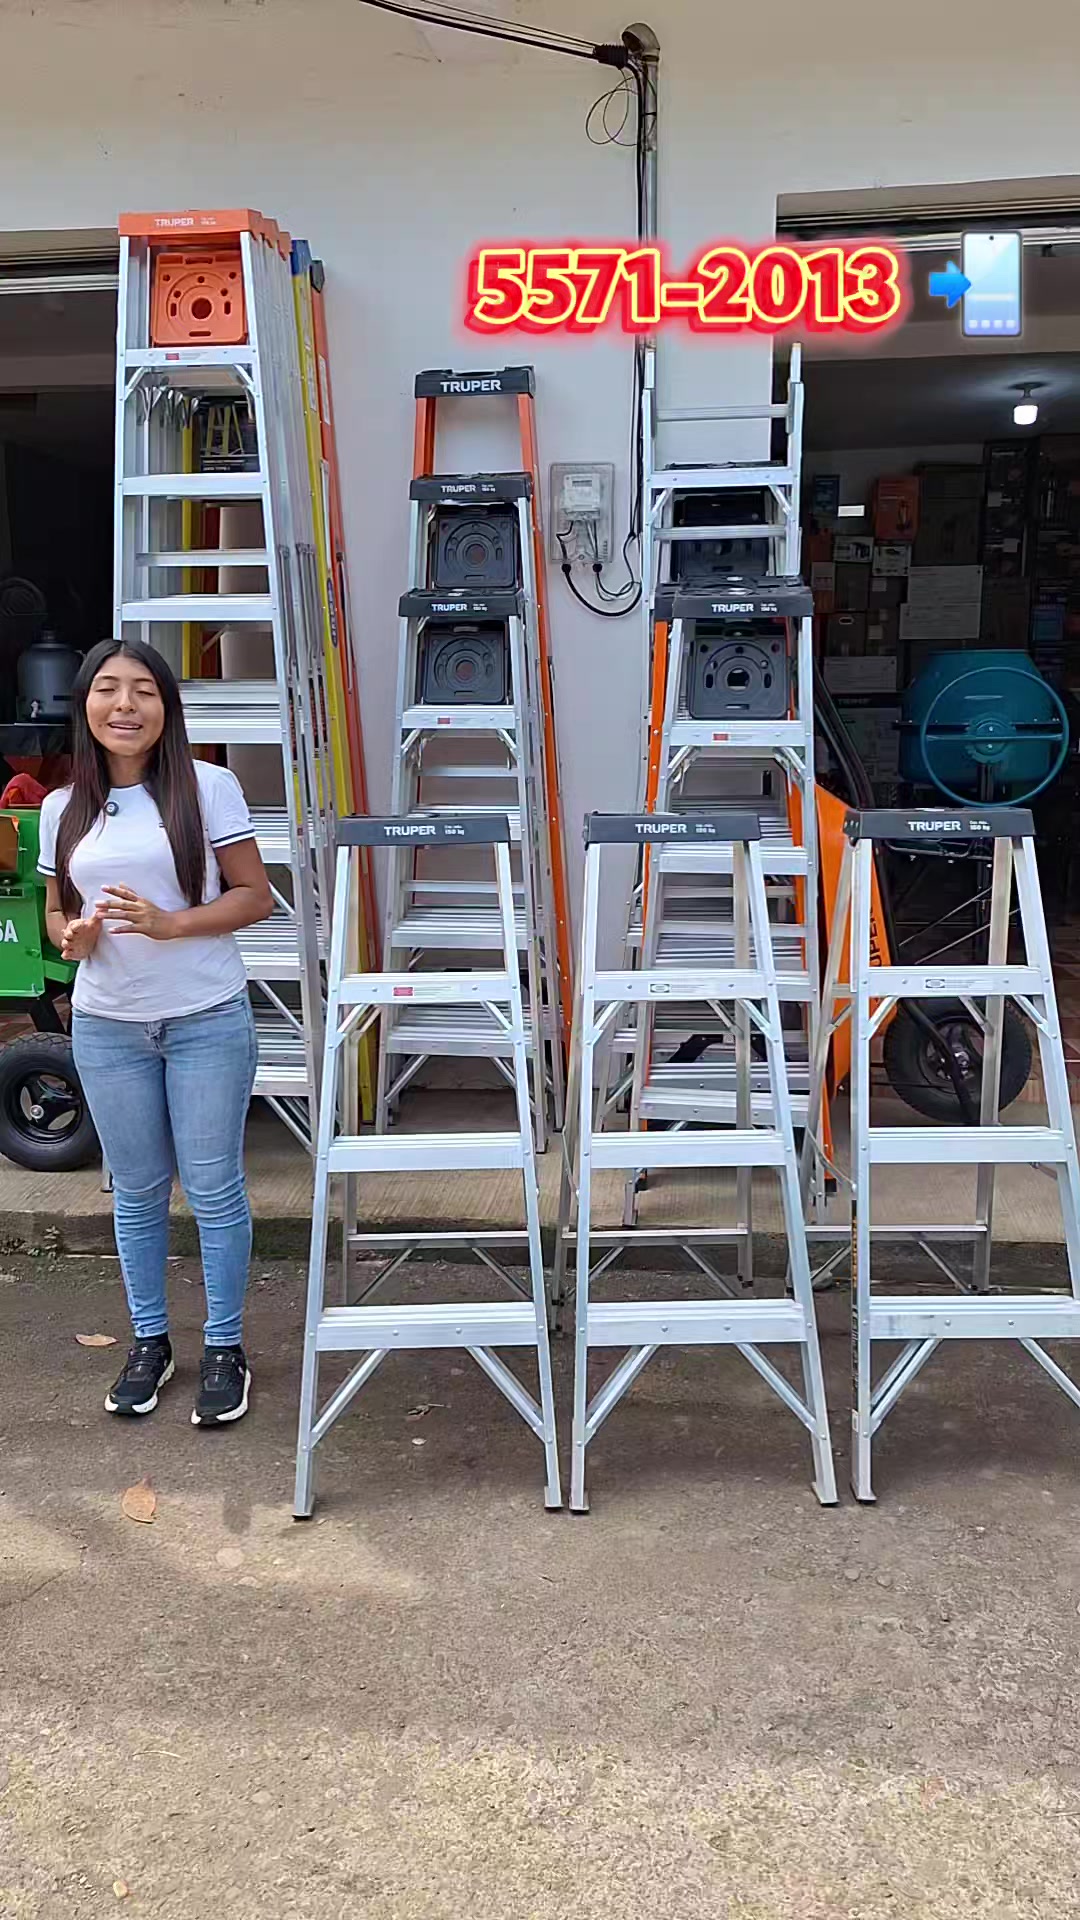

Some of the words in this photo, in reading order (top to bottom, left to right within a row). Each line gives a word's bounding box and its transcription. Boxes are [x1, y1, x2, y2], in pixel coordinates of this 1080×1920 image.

[155, 217, 194, 227] TRUPER
[440, 379, 502, 393] TRUPER
[440, 484, 477, 493] TRUPER
[712, 604, 754, 612] TRUPER
[383, 825, 437, 836] TRUPER
[634, 823, 688, 834] TRUPER
[907, 820, 962, 831] TRUPER
